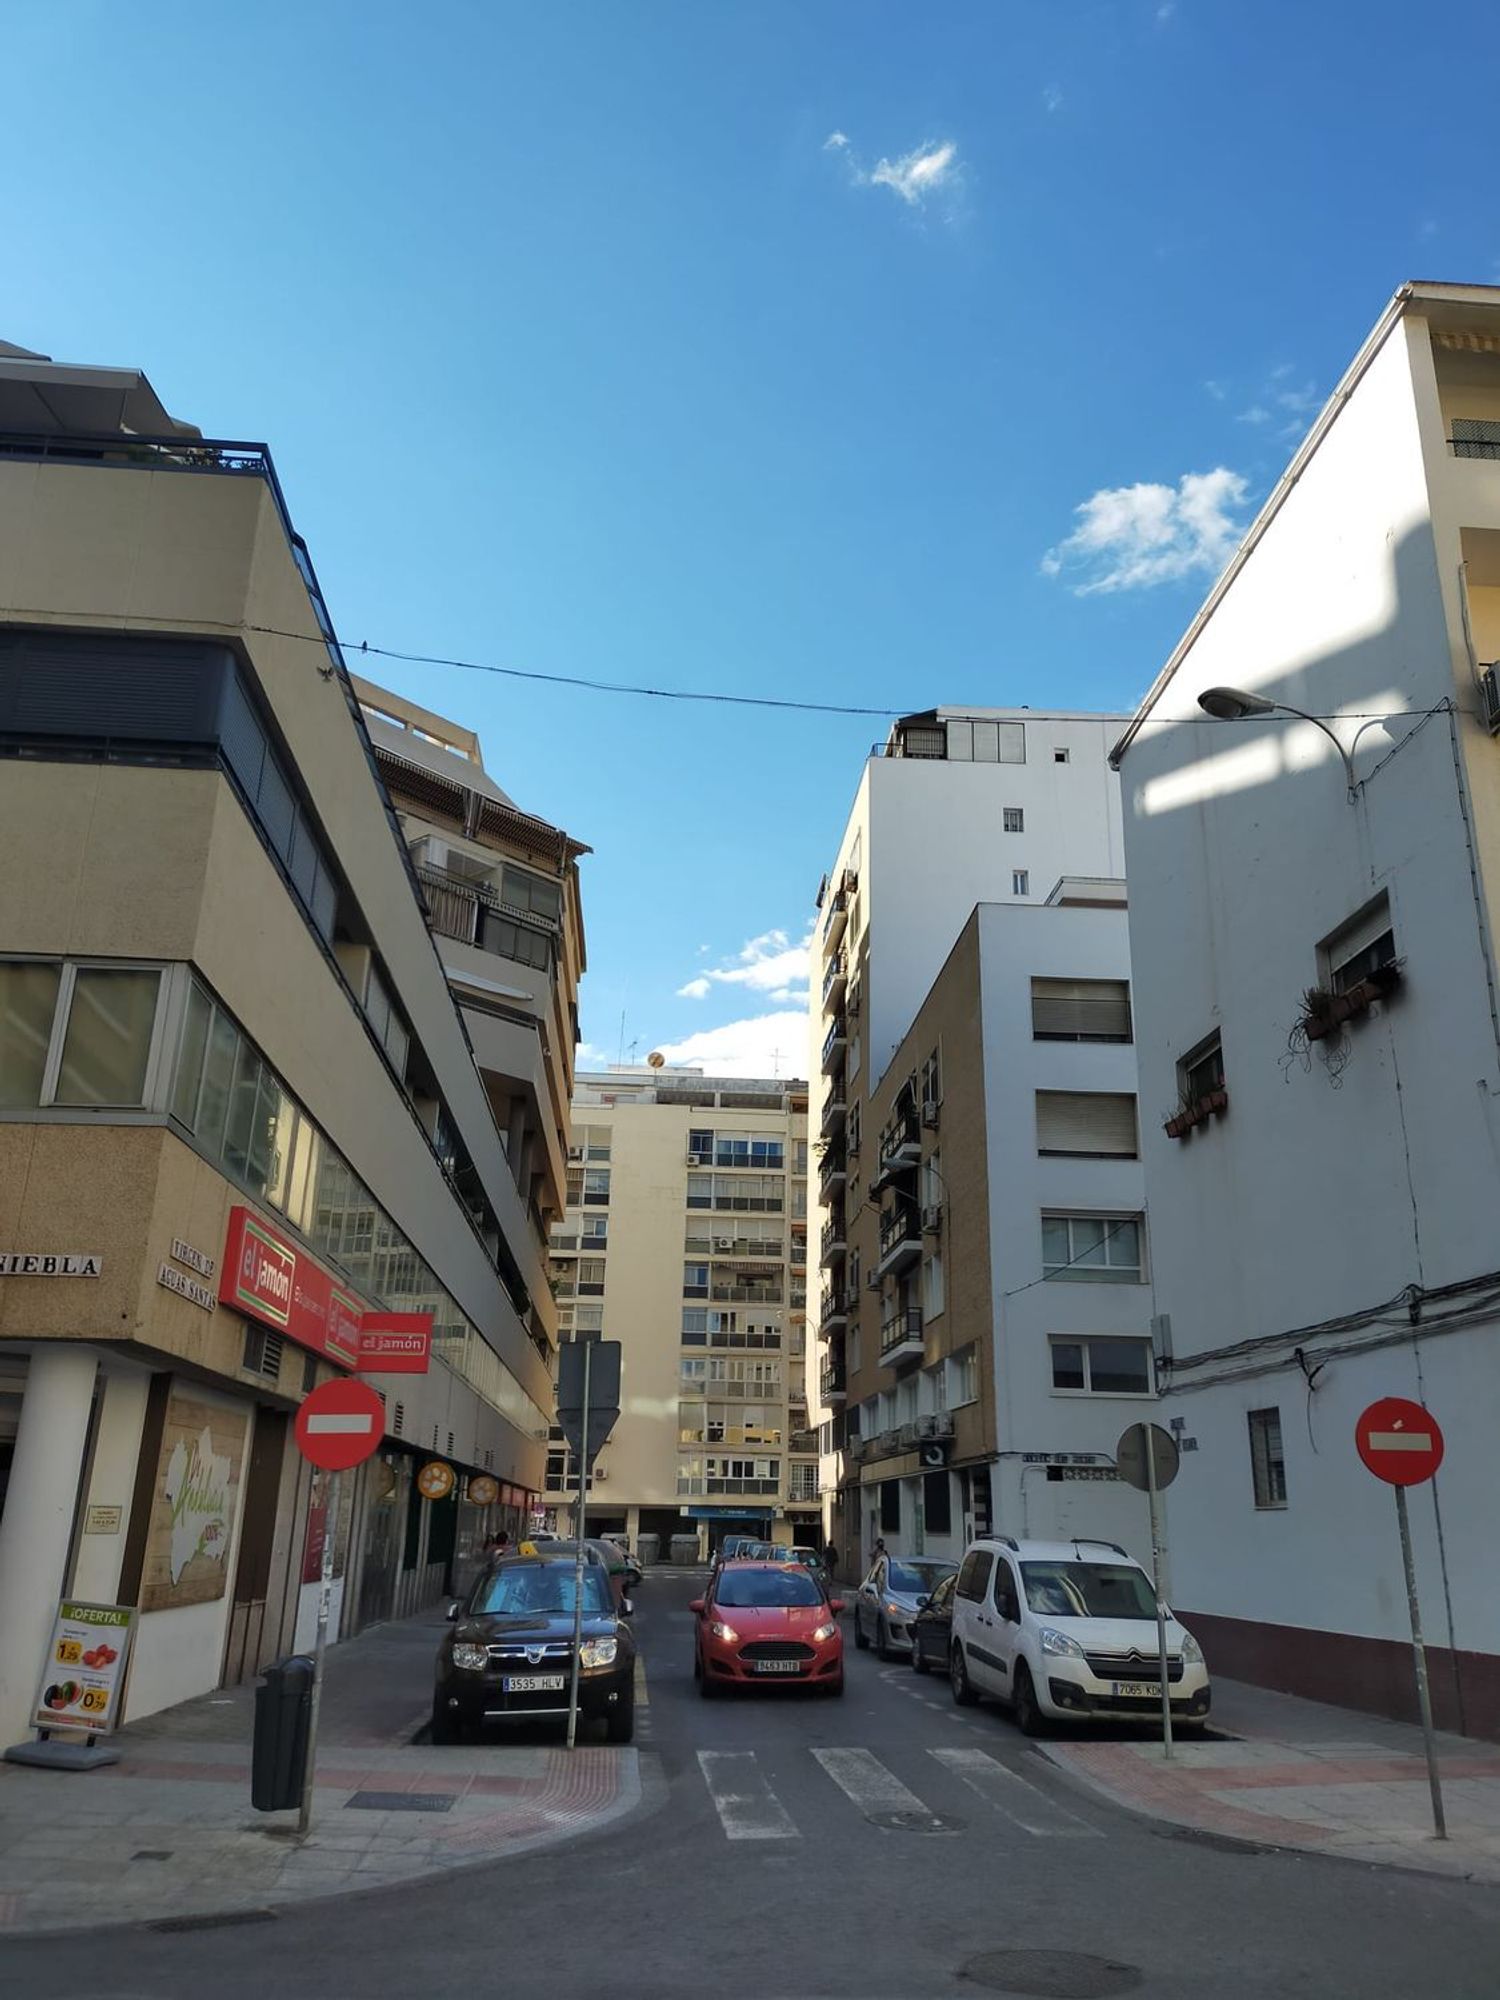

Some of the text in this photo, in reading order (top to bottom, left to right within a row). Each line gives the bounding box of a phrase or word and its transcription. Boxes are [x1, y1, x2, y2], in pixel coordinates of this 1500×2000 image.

[174, 1240, 214, 1276] VIRGEN DE
[243, 1241, 290, 1302] el jamón
[160, 1264, 217, 1310] AGUAS SANTAS
[363, 1335, 420, 1350] el jamón
[71, 1606, 121, 1625] ¡OFERTA!
[510, 1676, 562, 1690] 3535 HLV
[1120, 1683, 1142, 1695] 7065
